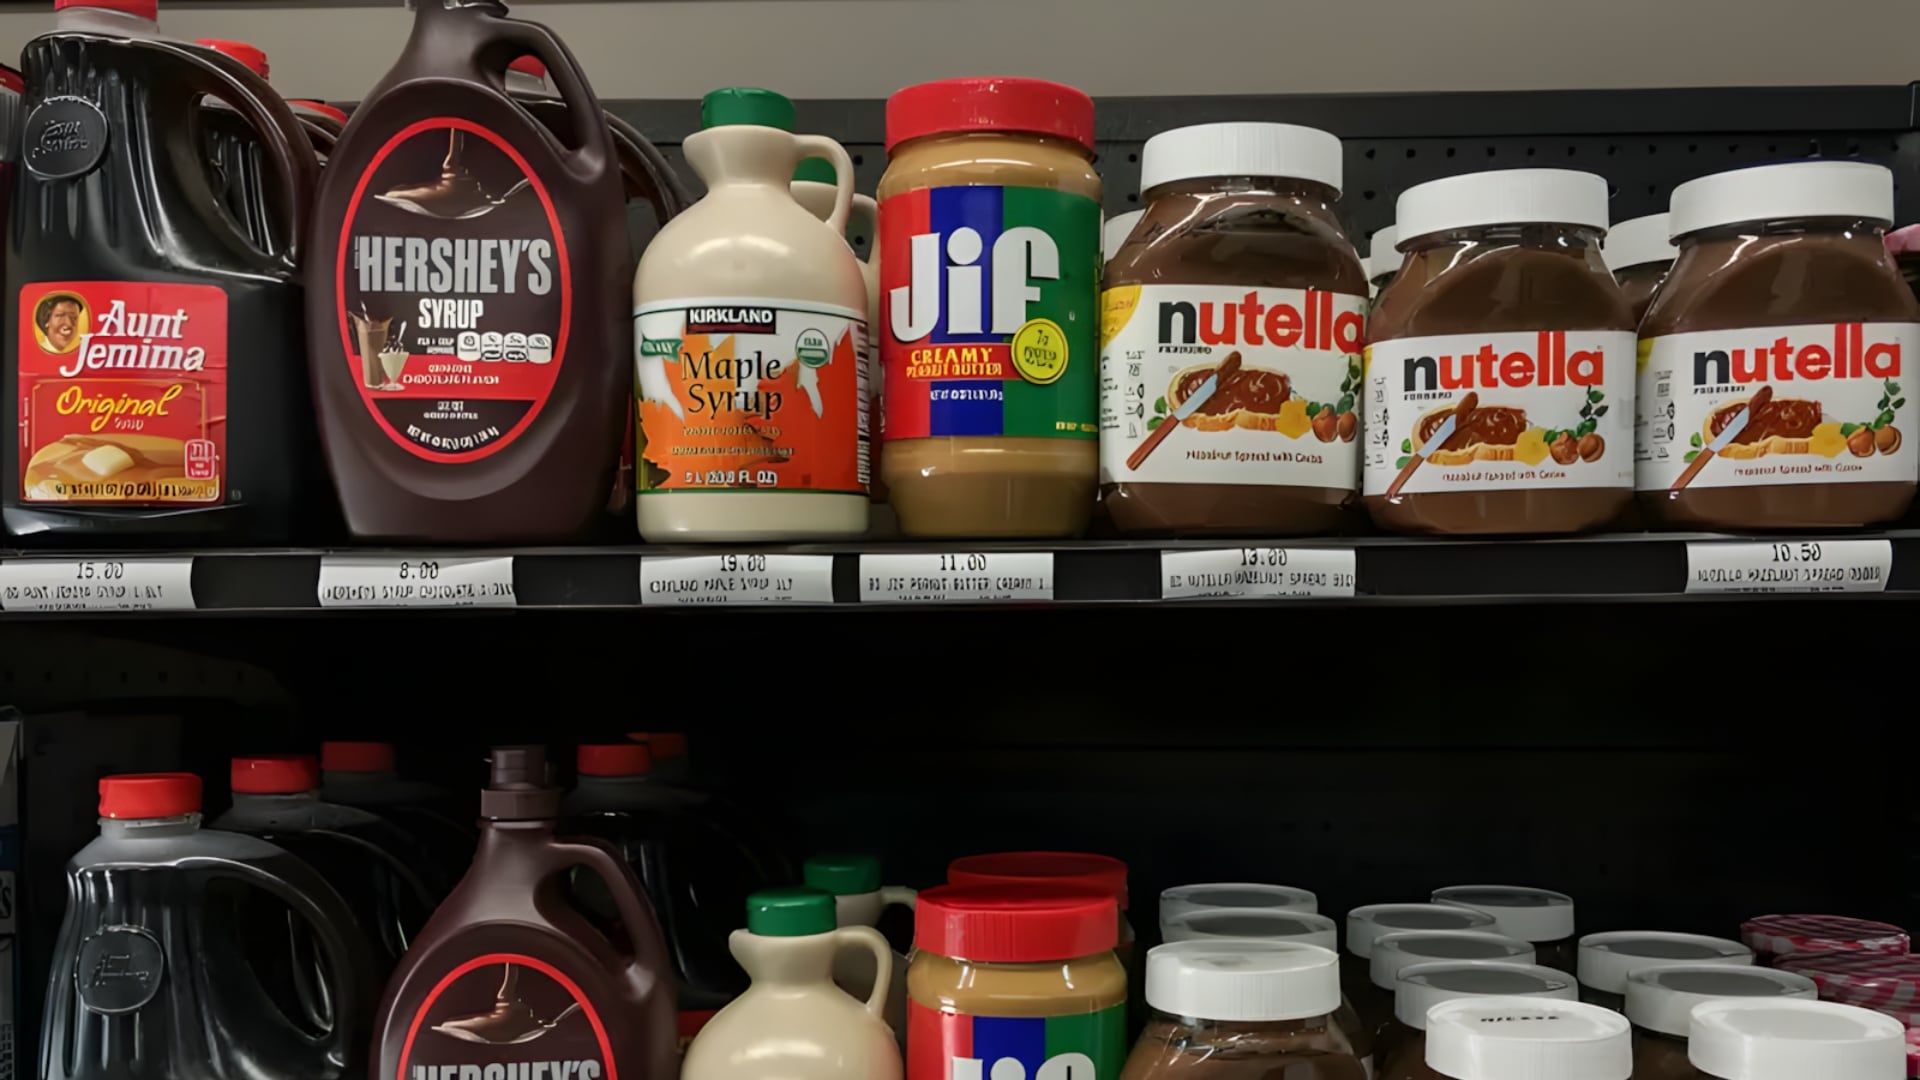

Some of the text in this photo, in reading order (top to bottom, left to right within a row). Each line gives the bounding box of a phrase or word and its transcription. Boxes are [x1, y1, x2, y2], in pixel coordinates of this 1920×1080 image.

[359, 236, 553, 296] HERSHEY'S
[889, 226, 1060, 343] Jif
[97, 300, 189, 339] Aunt
[418, 298, 484, 329] SYRUP
[689, 308, 773, 325] KIRKLAND
[1158, 288, 1364, 354] nutella
[59, 333, 206, 378] Jemima
[681, 350, 782, 388] Maple
[911, 347, 993, 365] CREAMY
[1403, 331, 1604, 392] nutella
[1693, 322, 1902, 386] nutella
[56, 384, 184, 432] Original
[688, 383, 782, 420] Syrup
[76, 561, 124, 580] 15.00
[399, 561, 439, 579] 8.00
[720, 554, 767, 572] 19.00
[940, 554, 987, 571] 11.00
[1772, 543, 1822, 562] 10.50
